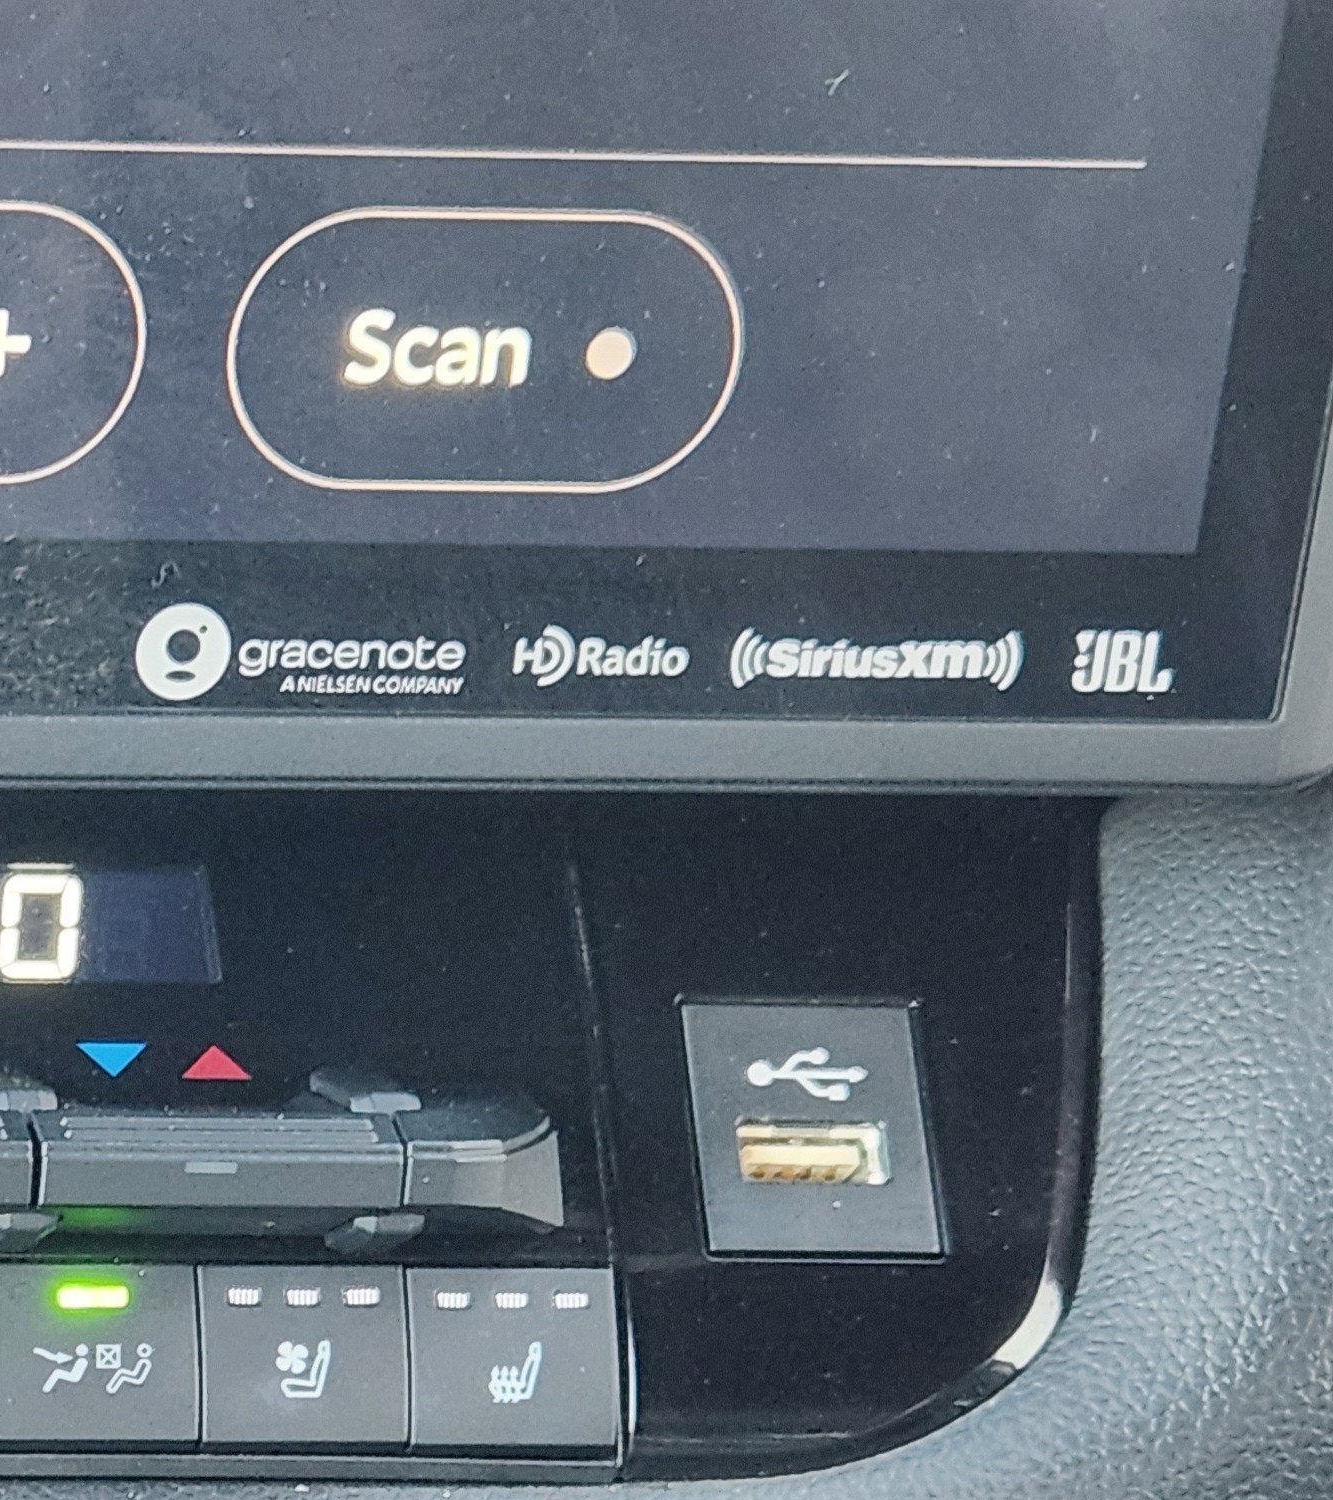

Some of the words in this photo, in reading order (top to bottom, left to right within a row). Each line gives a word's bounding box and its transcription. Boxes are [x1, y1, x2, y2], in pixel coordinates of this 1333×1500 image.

[343, 308, 532, 388] Scan
[238, 635, 467, 677] gracenote
[576, 635, 690, 677] Radio
[1071, 630, 1173, 693] JBL
[279, 675, 295, 693] A
[297, 674, 371, 694] NIELSEN
[372, 674, 465, 695] COMPANY
